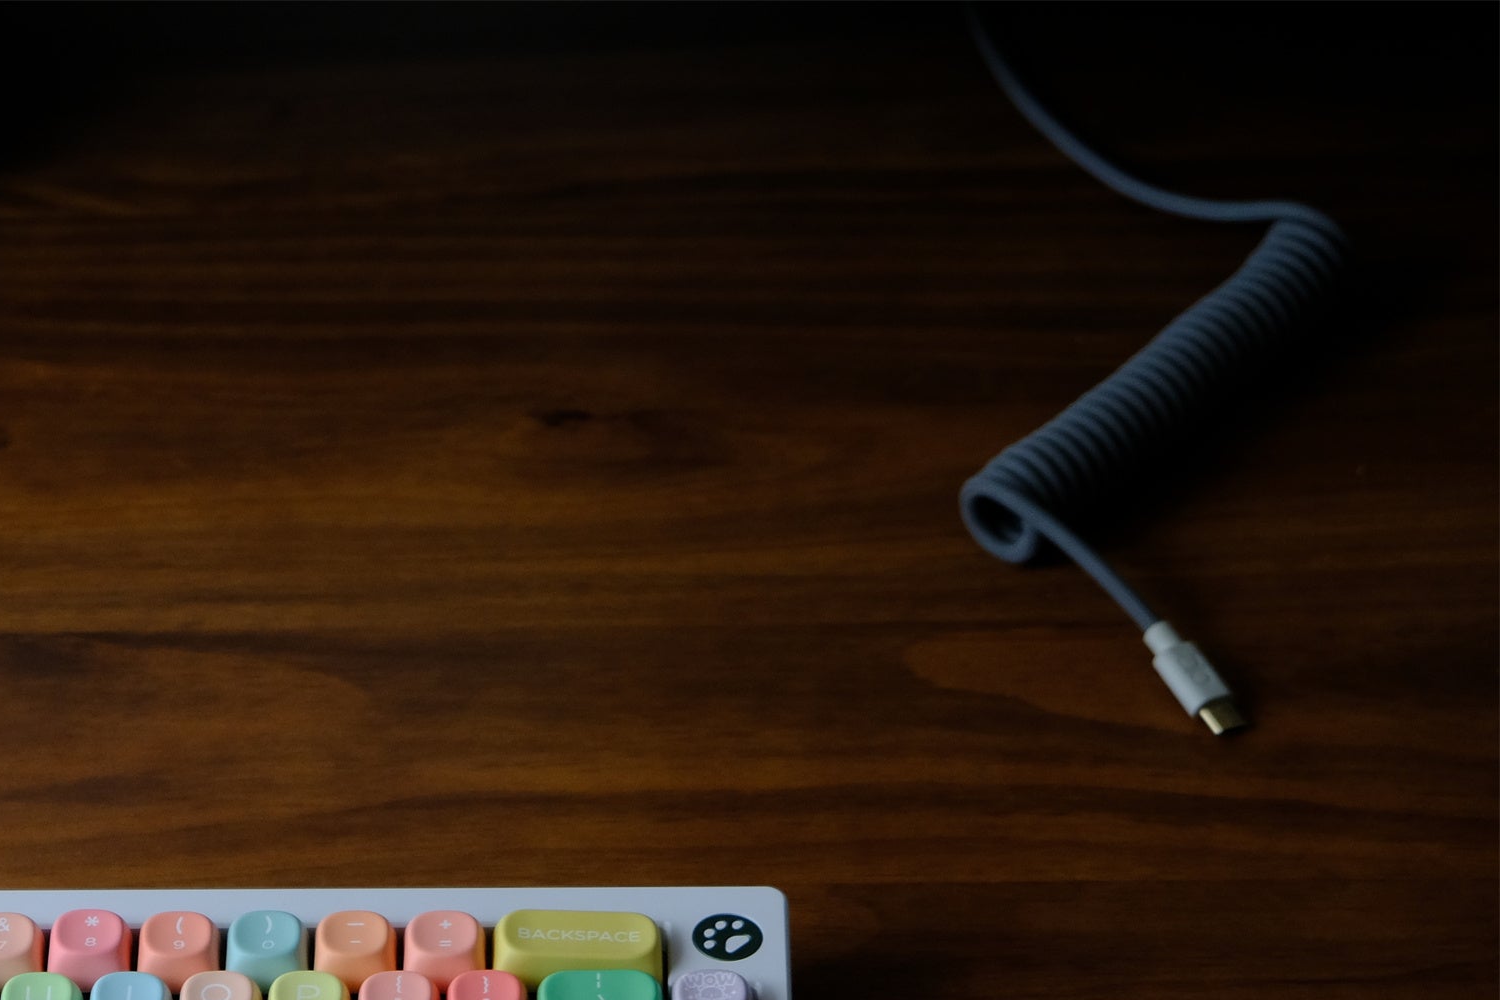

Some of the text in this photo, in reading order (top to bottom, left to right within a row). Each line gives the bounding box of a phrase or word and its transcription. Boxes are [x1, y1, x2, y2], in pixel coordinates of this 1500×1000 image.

[175, 916, 184, 934] (
[265, 915, 273, 934] )
[438, 919, 453, 930] +
[517, 927, 641, 943] BACKSPACE
[84, 936, 97, 947] 8
[173, 939, 185, 950] 9
[438, 939, 452, 947] =
